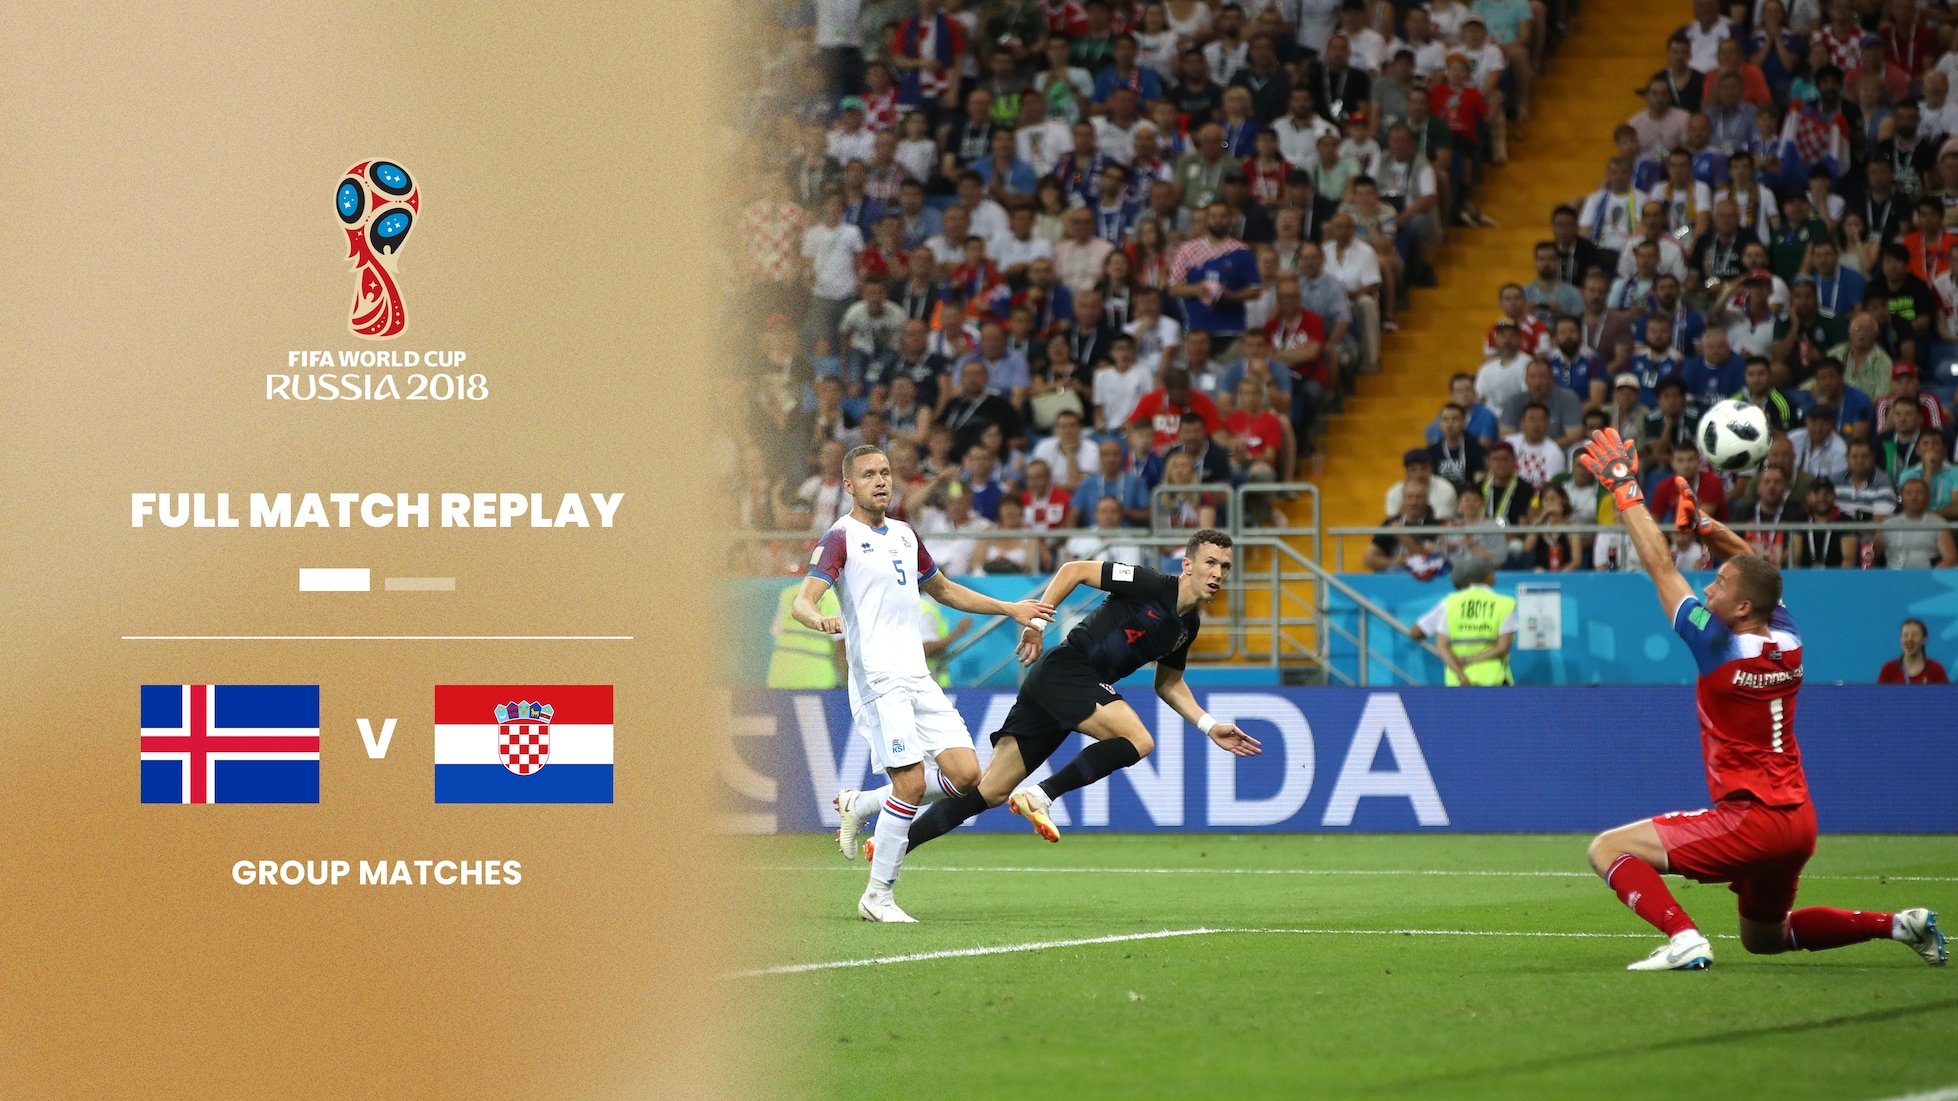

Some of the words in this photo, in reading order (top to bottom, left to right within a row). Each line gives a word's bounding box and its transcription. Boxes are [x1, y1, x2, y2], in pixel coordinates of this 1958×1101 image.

[892, 559, 907, 586] 5
[1460, 599, 1496, 619] 18011
[1123, 628, 1147, 644] 4
[1770, 697, 1784, 753] 1
